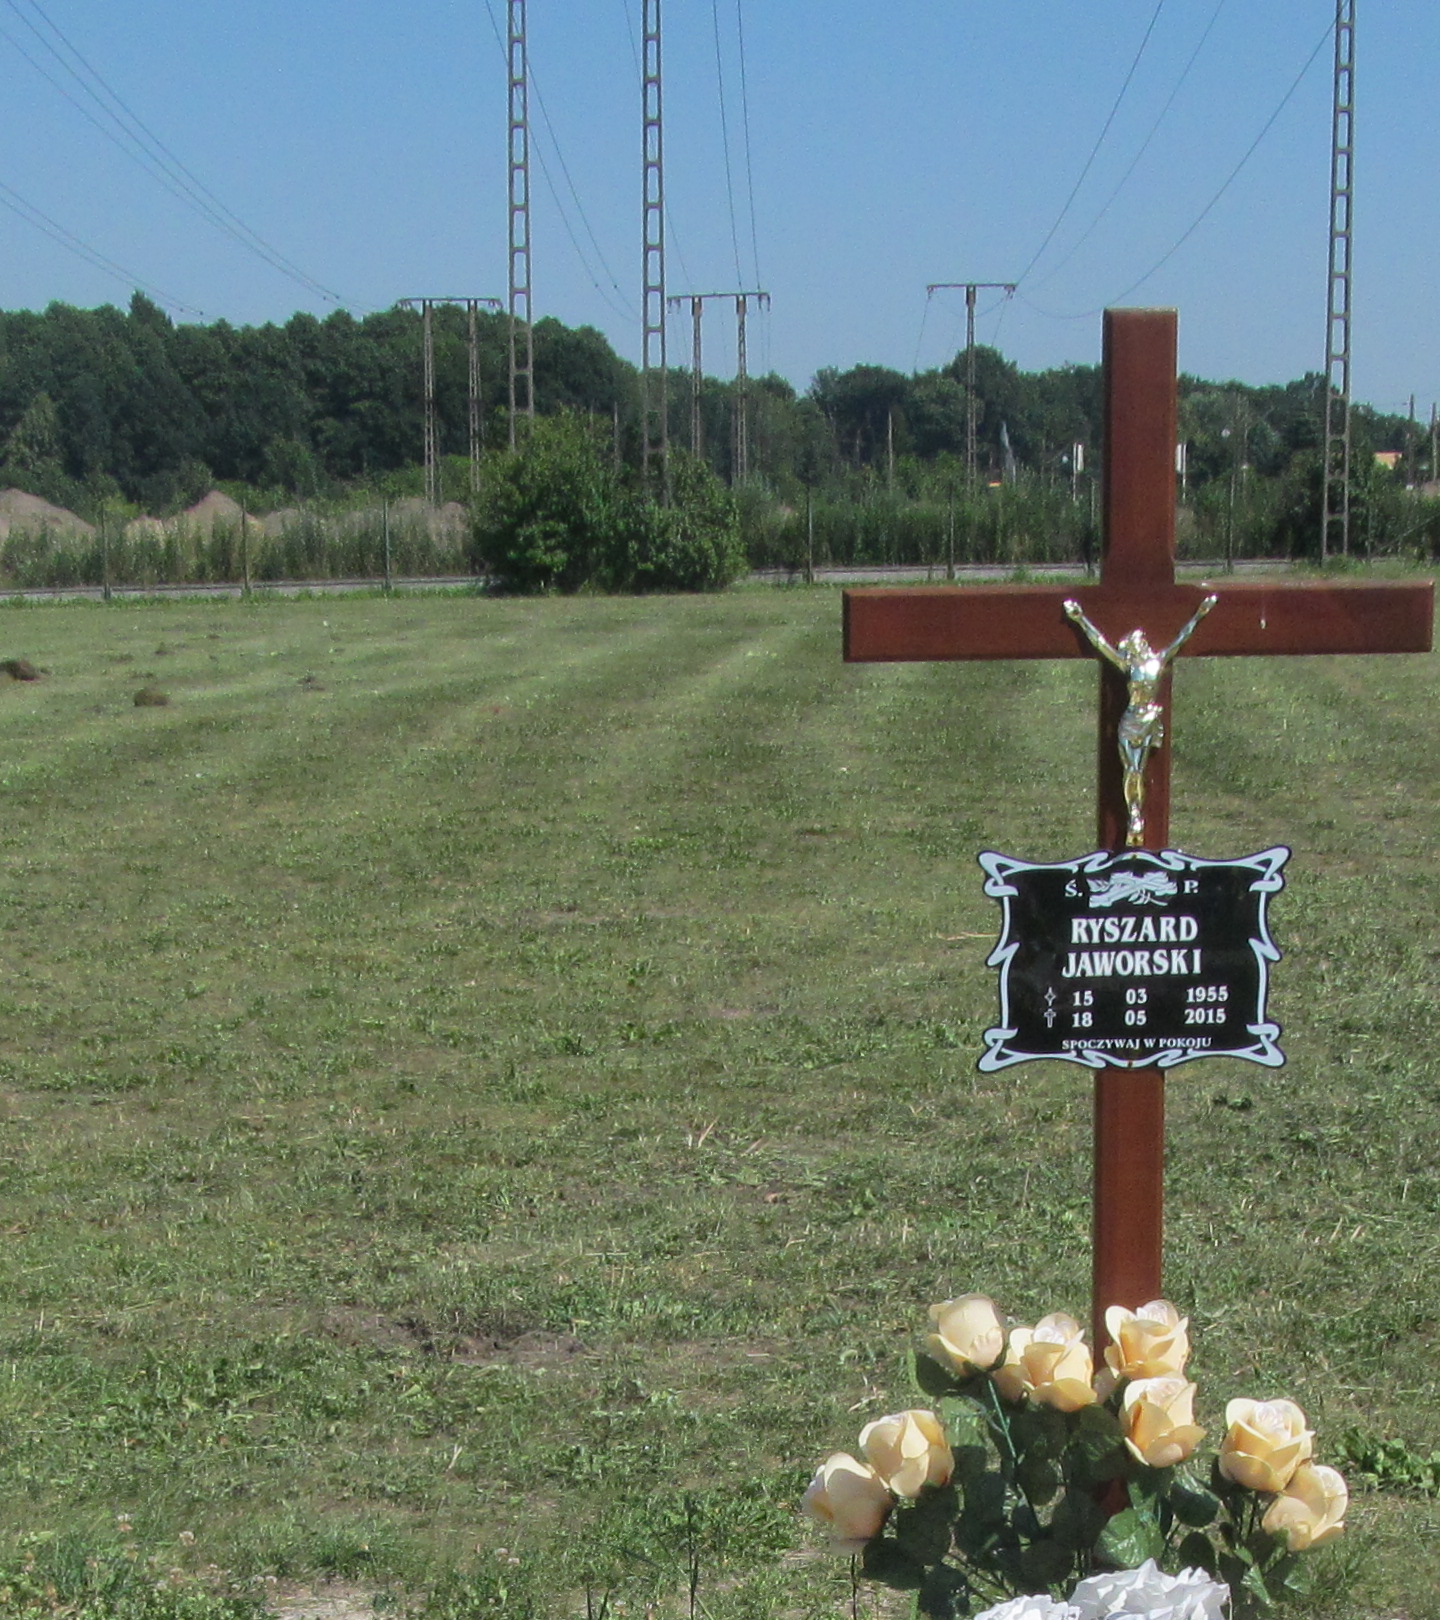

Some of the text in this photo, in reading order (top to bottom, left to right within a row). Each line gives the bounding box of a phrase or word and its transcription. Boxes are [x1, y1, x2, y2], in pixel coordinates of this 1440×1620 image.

[1183, 880, 1199, 894] P.
[1070, 916, 1199, 944] RYSZARD
[1061, 949, 1202, 978] JAWORSKI
[1072, 986, 1229, 1007] 15 03 1955
[1071, 1008, 1227, 1028] 18 05 2015
[1061, 1037, 1212, 1050] SPOCZYWAJ W POKOJU
